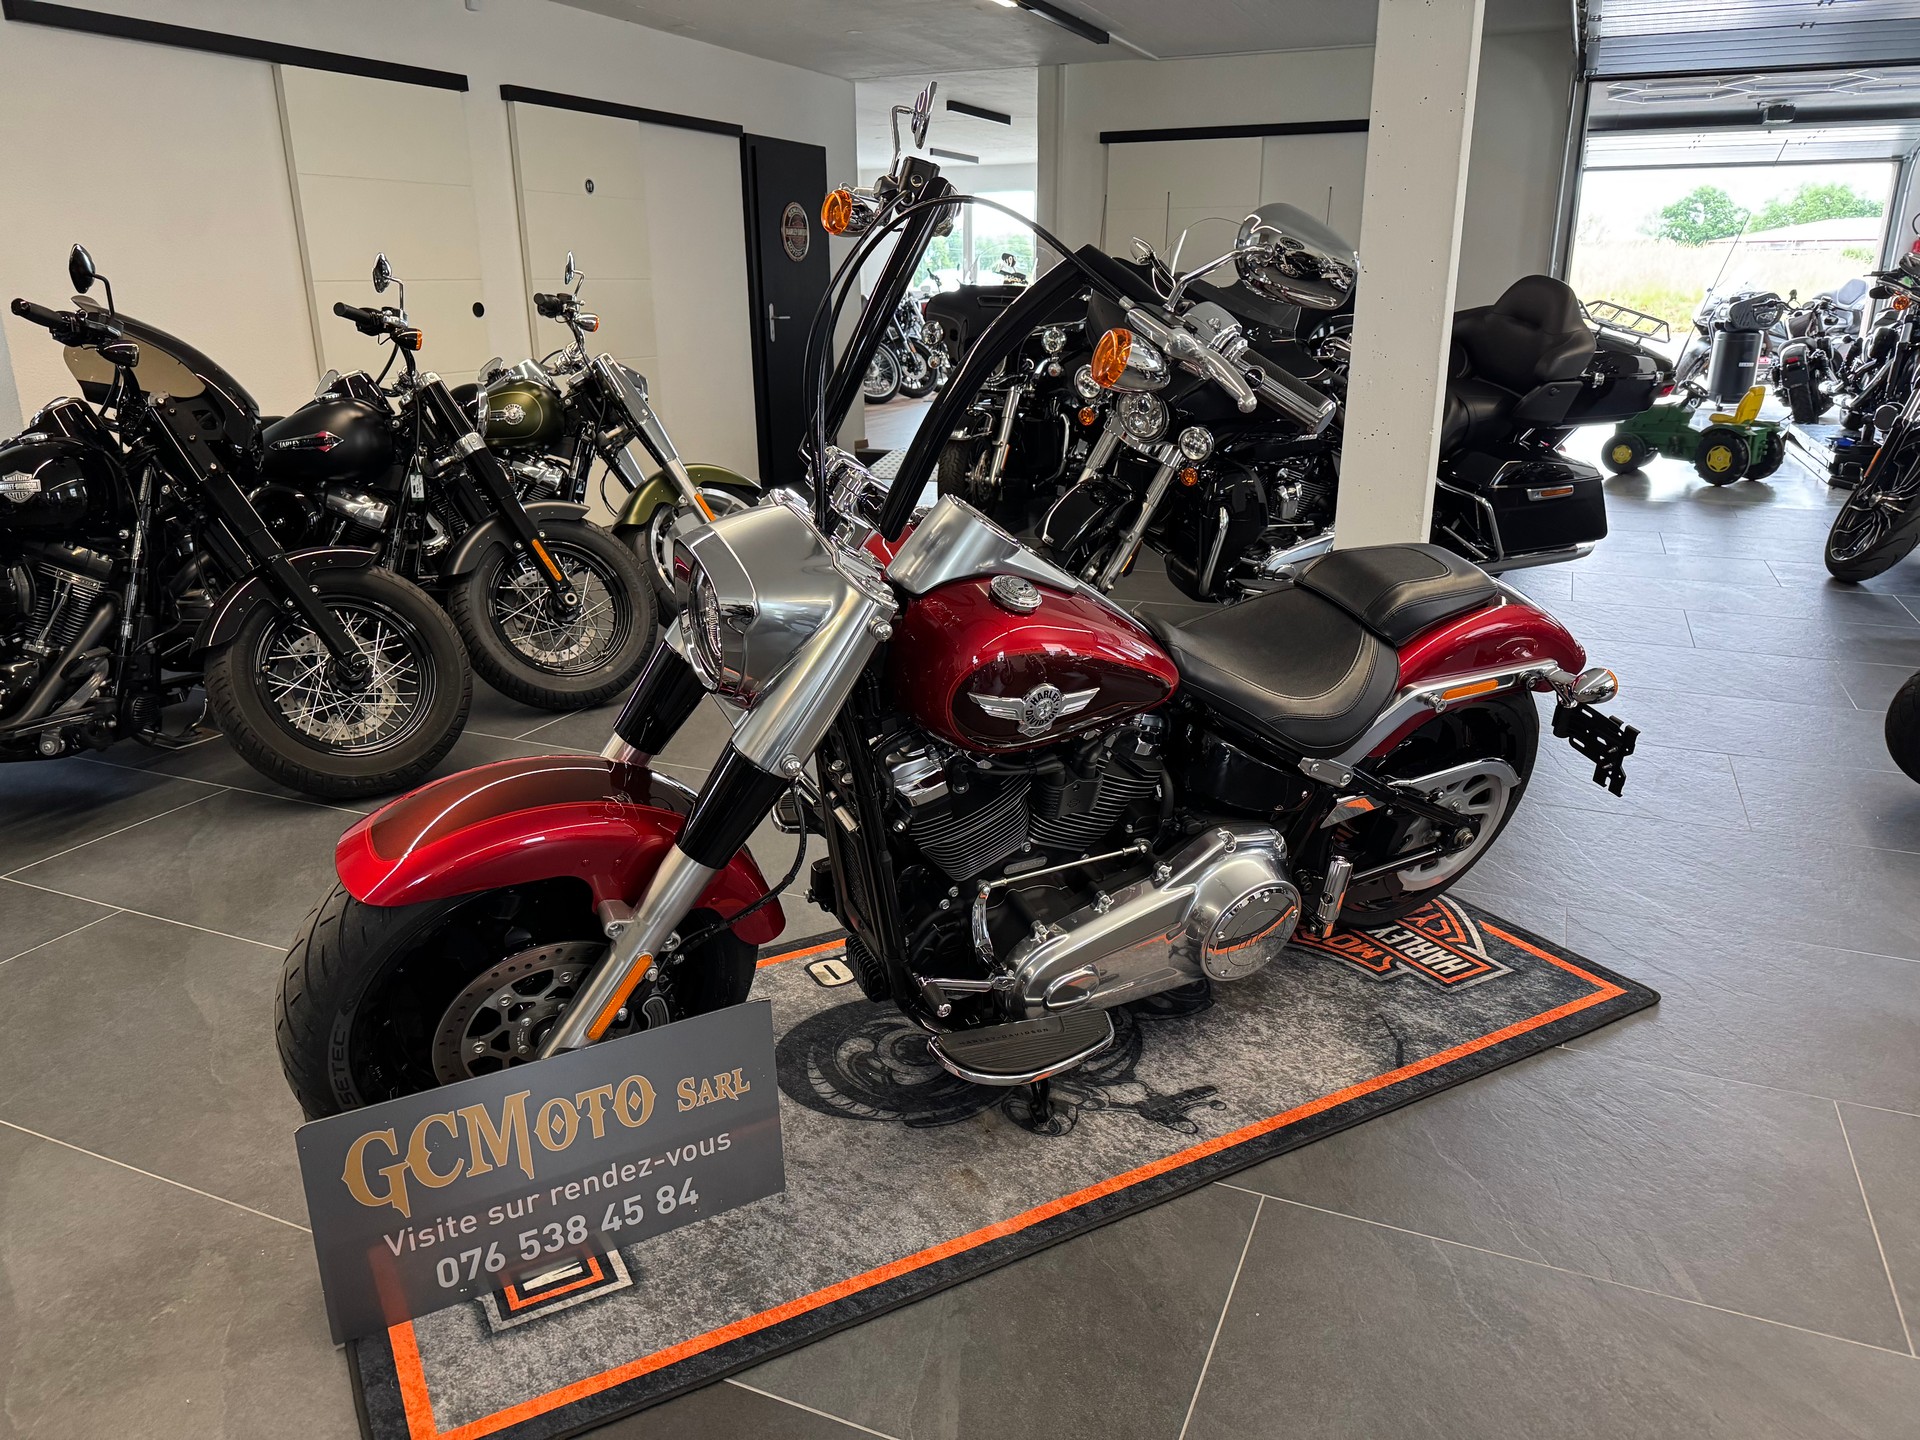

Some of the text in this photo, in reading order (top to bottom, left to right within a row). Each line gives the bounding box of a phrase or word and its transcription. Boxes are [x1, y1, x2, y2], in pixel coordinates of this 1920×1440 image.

[1025, 708, 1059, 726] DAVIDSON
[1030, 690, 1060, 705] HARLEY
[1365, 925, 1472, 974] HARLEY
[383, 1132, 732, 1257] Visite sur rendez-vous
[436, 1241, 506, 1289] 076
[518, 1214, 589, 1261] 538
[601, 1194, 644, 1232] 45
[656, 1176, 699, 1214] 84
